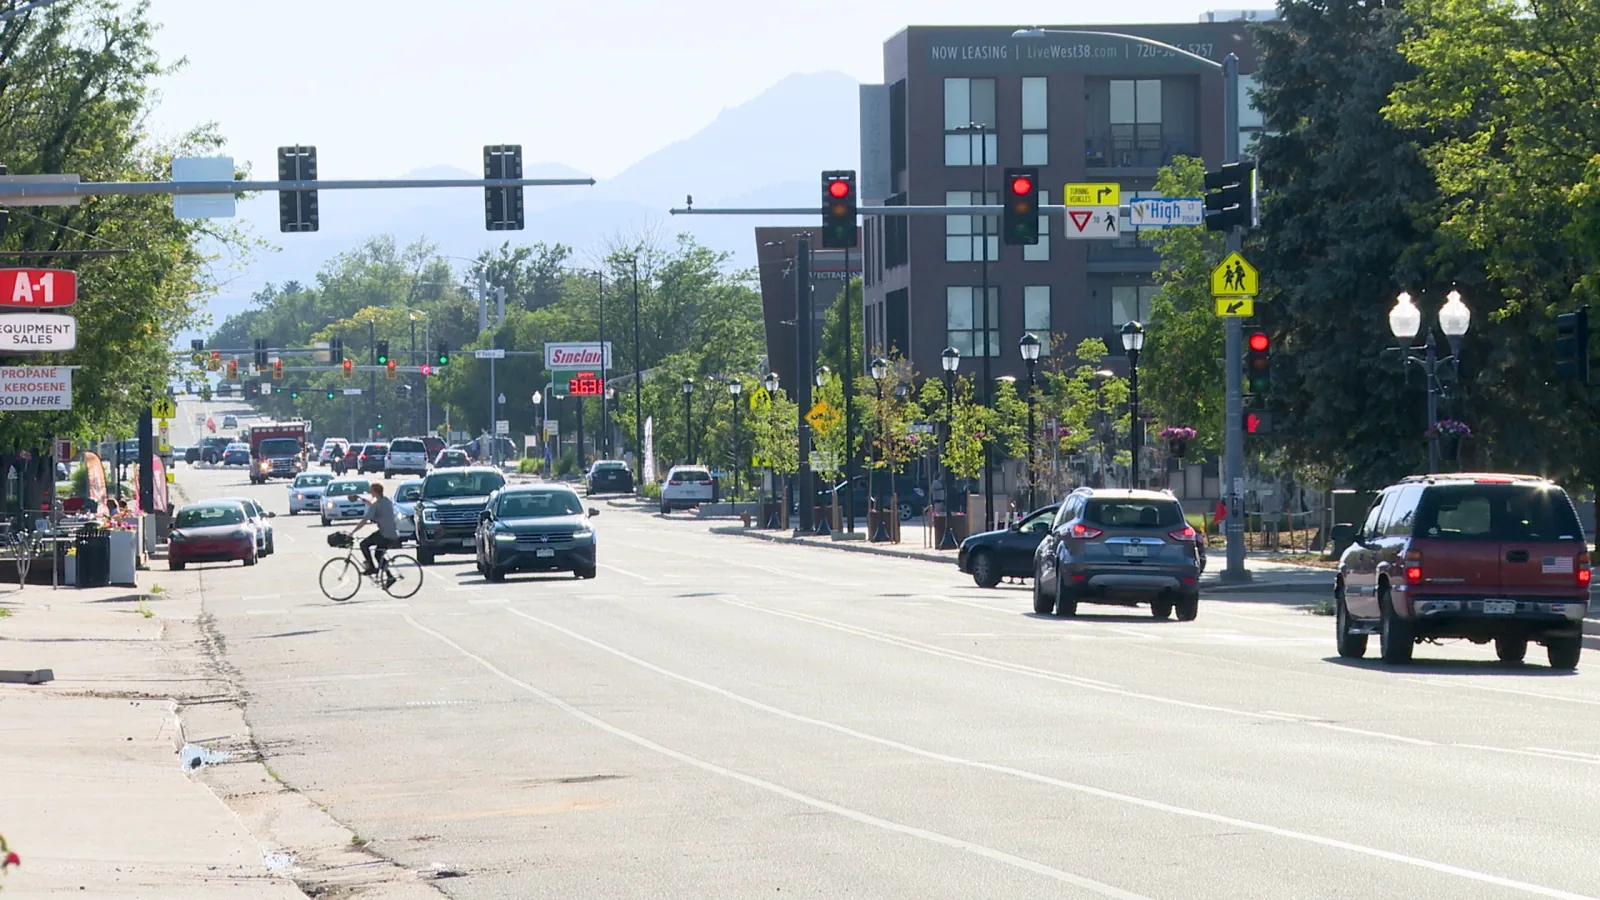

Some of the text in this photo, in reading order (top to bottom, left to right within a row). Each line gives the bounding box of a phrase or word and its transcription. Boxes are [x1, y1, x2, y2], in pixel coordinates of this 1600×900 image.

[932, 43, 1213, 59] NOW LEASING LiveWest38.com 720-5257
[1070, 195, 1091, 203] VEHICLES
[1151, 202, 1180, 223] High
[12, 272, 54, 302] A-1
[13, 335, 53, 344] SALES
[2, 369, 57, 379] PROPANE
[4, 382, 66, 393] KEROSENE
[0, 395, 62, 406] SOLD HERE
